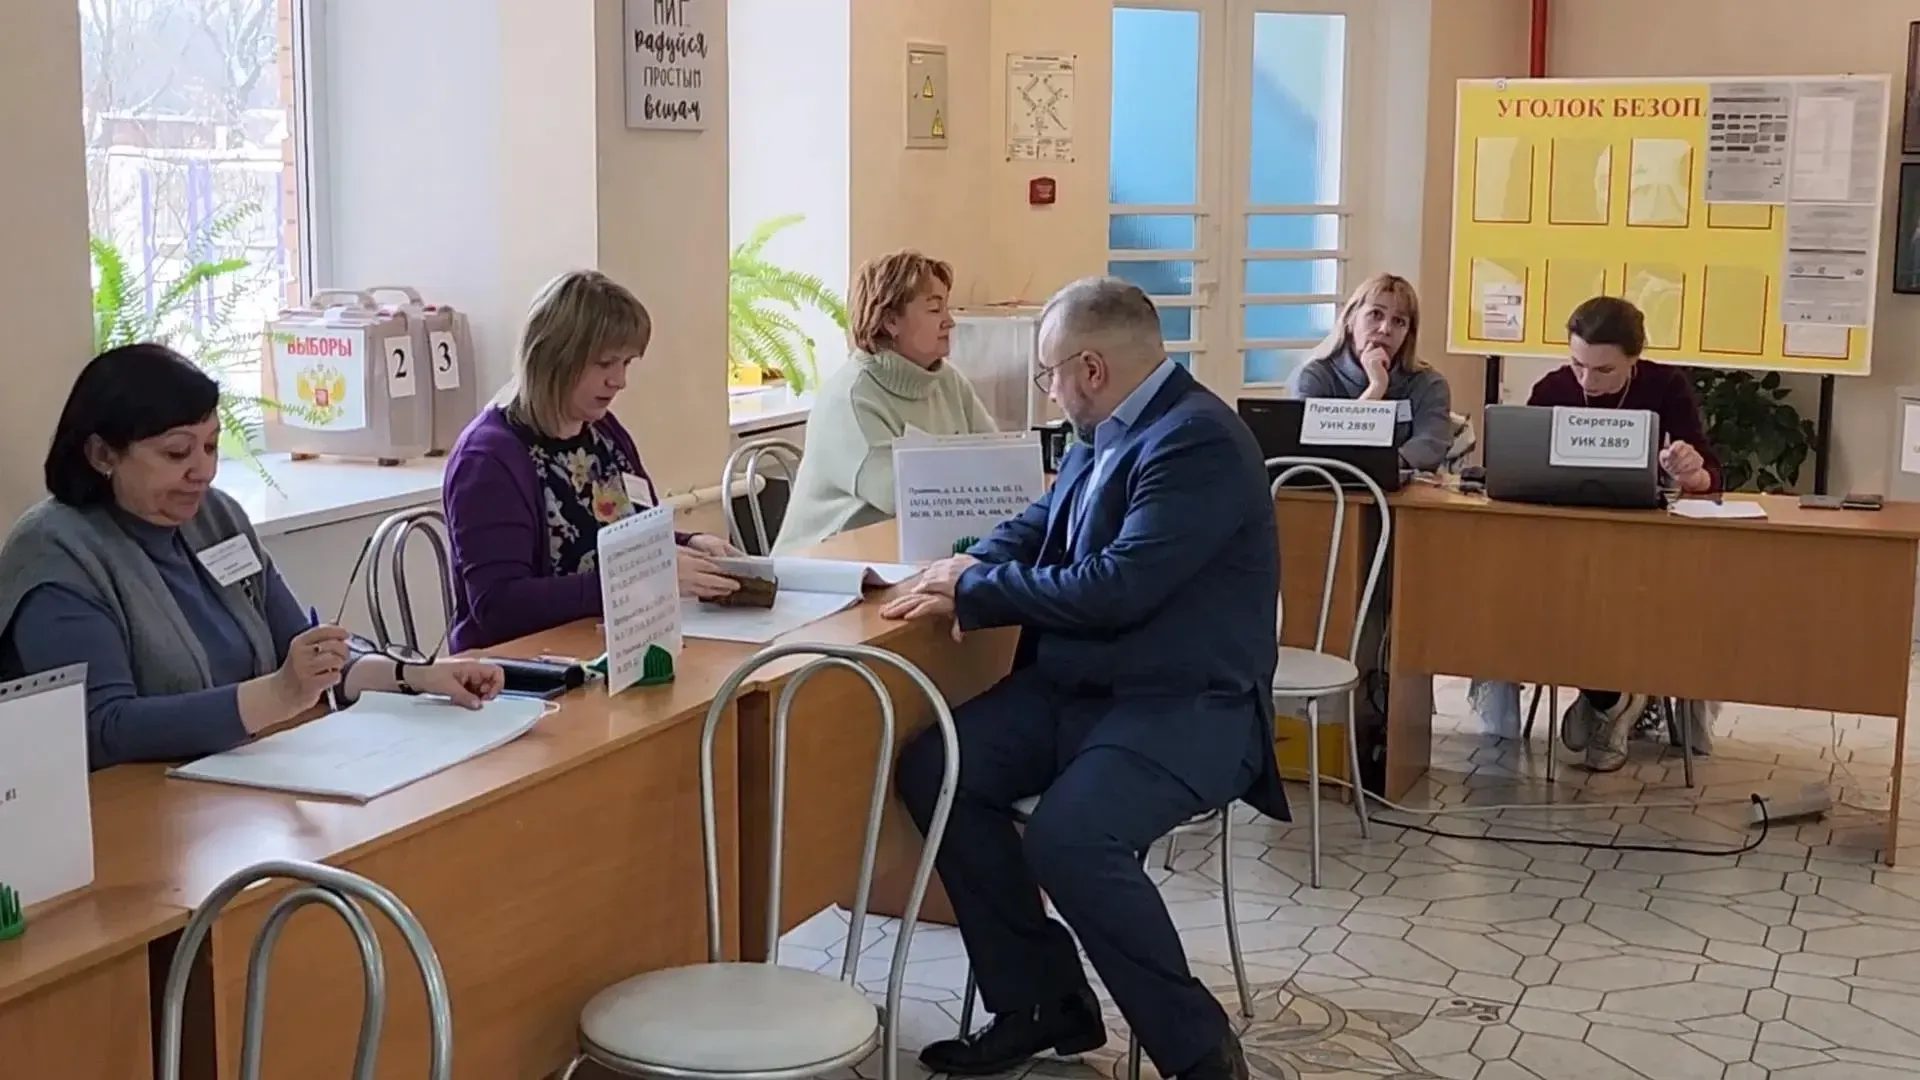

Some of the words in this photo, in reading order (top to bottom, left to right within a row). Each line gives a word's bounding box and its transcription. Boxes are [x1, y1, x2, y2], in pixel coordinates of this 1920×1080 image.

[1497, 98, 1605, 118] УГОЛОК
[1613, 97, 1707, 118] БЕЗОП
[287, 336, 352, 357] ВЫБОРЫ
[392, 348, 407, 379] 2
[437, 342, 452, 372] 3
[1309, 403, 1392, 415] Председатель
[1320, 421, 1344, 430] УИК
[1347, 421, 1376, 431] 2889
[1568, 415, 1635, 429] Секретарь
[1570, 436, 1597, 446] УИК
[1599, 437, 1630, 448] 2889
